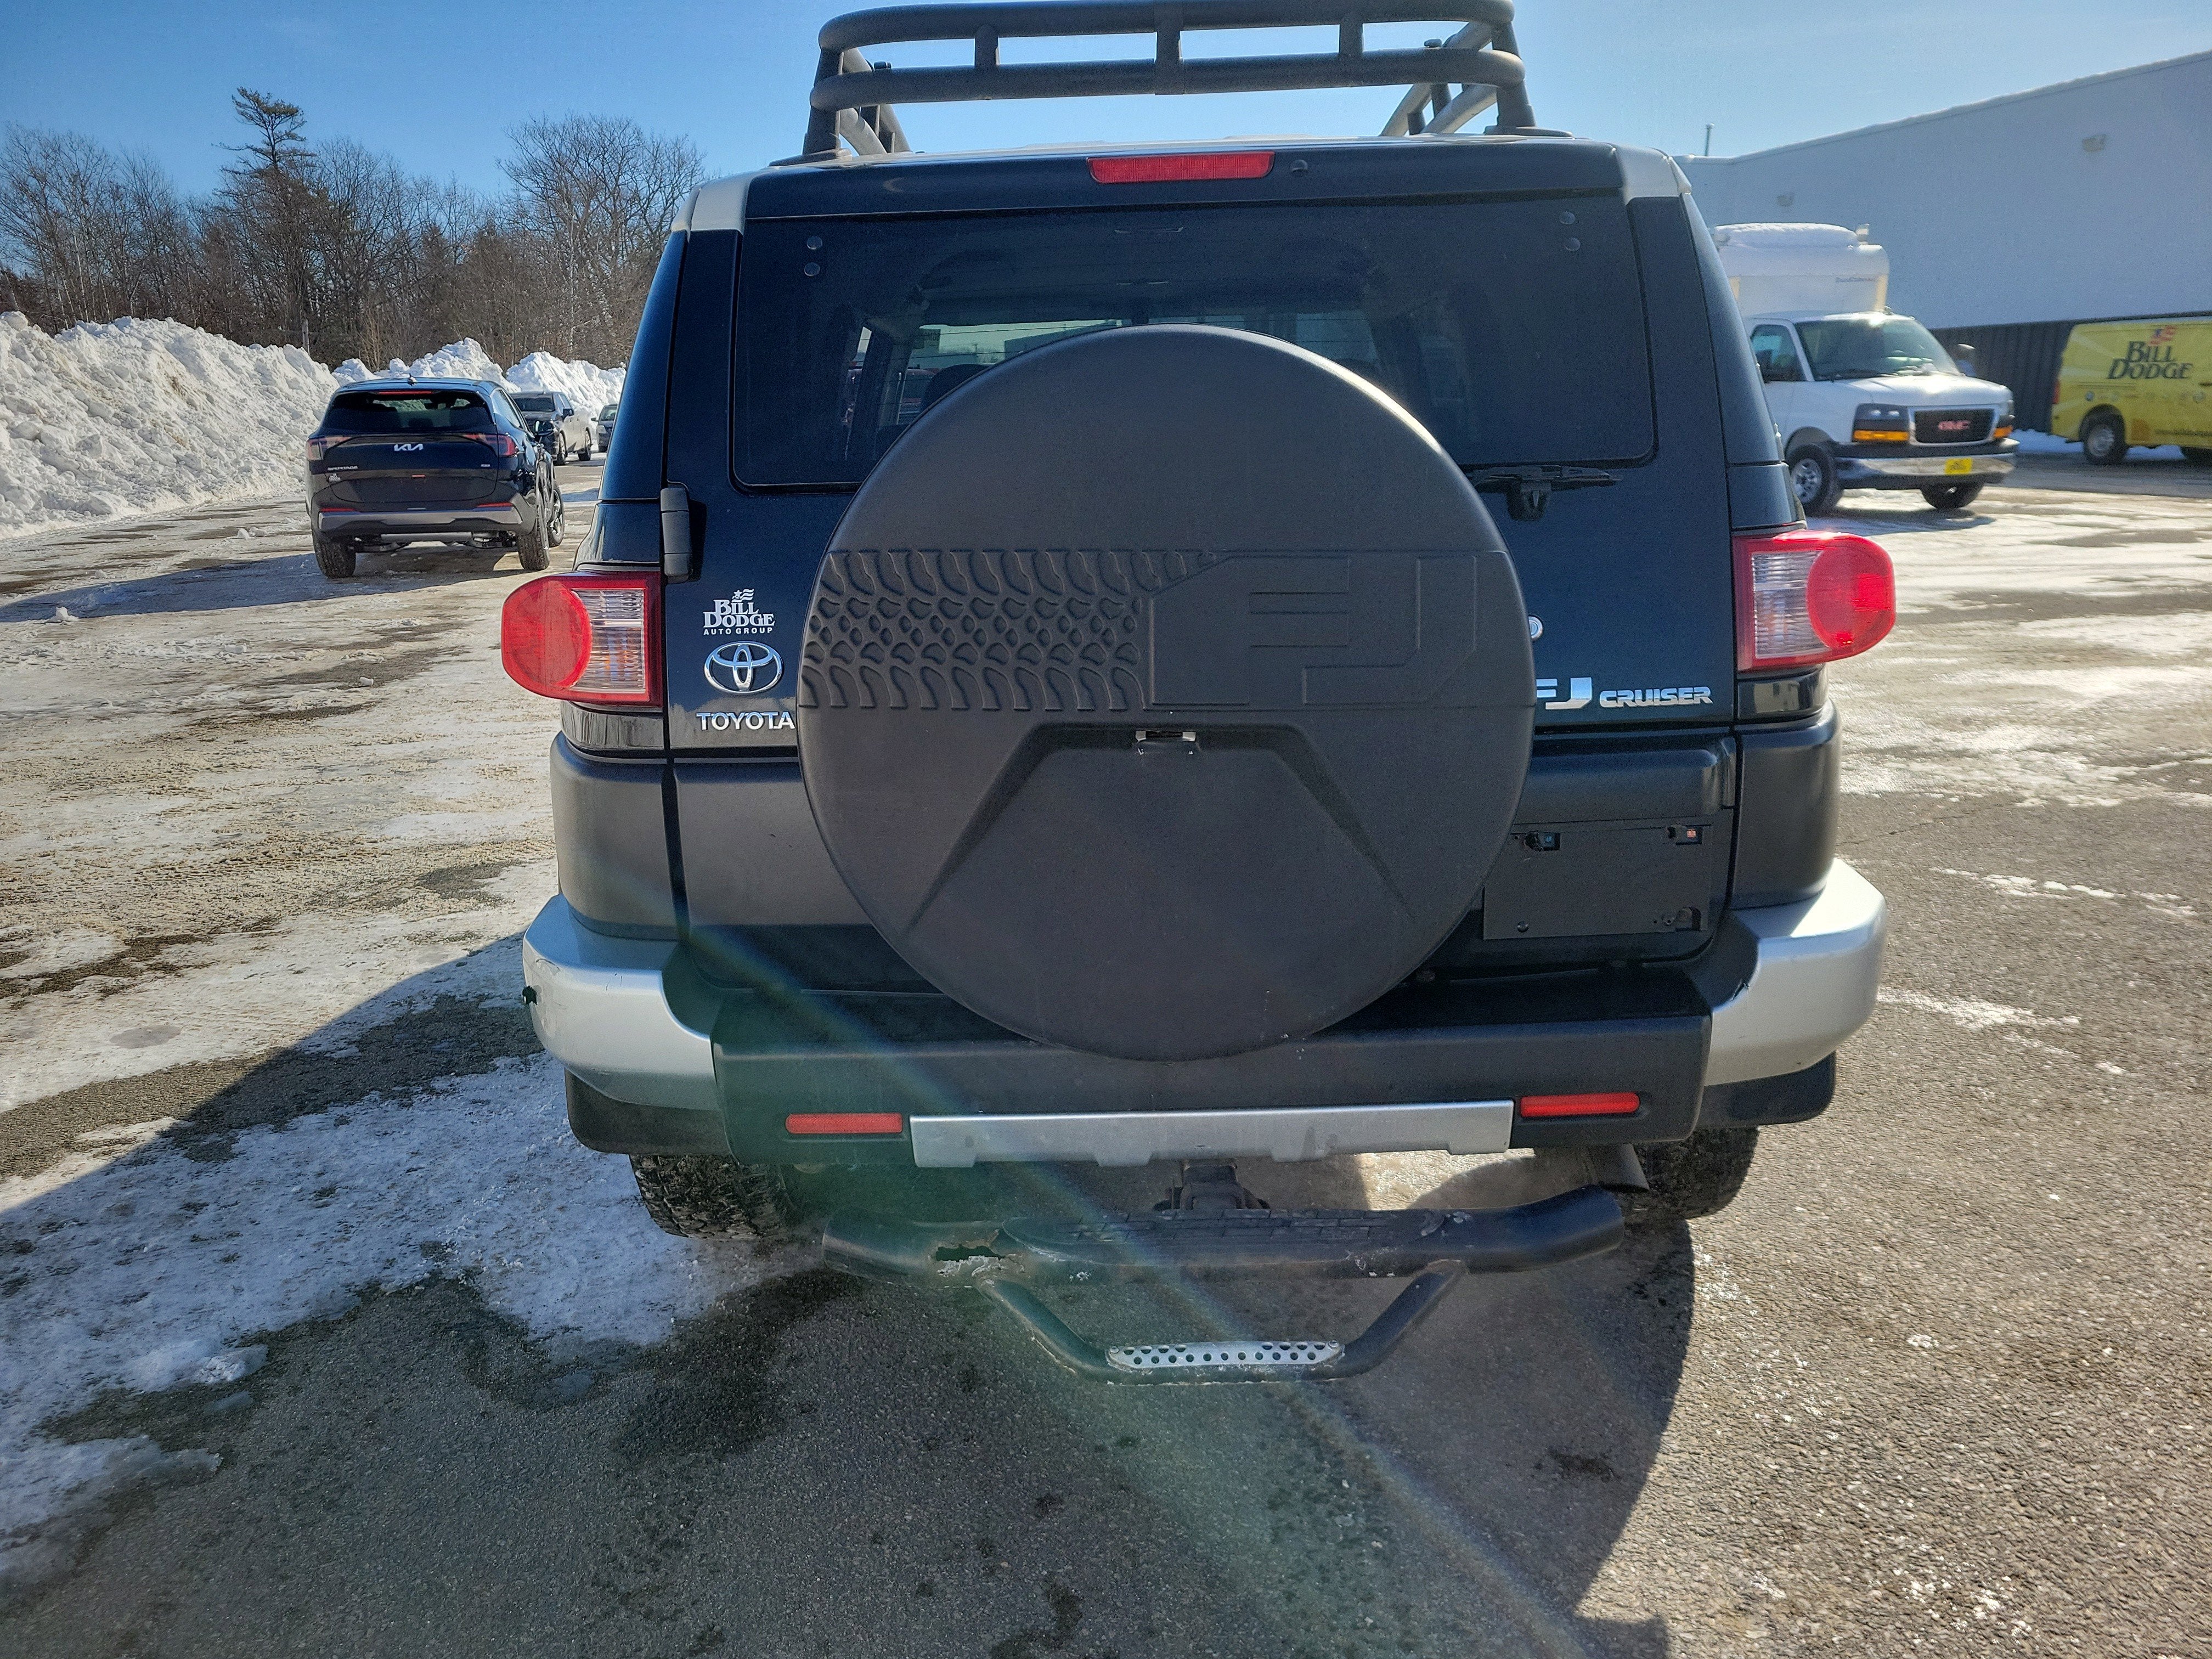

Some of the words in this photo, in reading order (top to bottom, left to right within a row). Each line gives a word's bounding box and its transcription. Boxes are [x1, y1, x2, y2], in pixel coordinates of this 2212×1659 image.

[2127, 340, 2176, 363] BILL
[2107, 358, 2193, 380] DODGE
[1938, 420, 1971, 430] GMC
[393, 443, 424, 452] KIA
[713, 599, 759, 615] BILL
[703, 611, 775, 628] DODGE
[1600, 686, 1713, 709] CRUISER
[696, 712, 796, 731] TOYOTA
